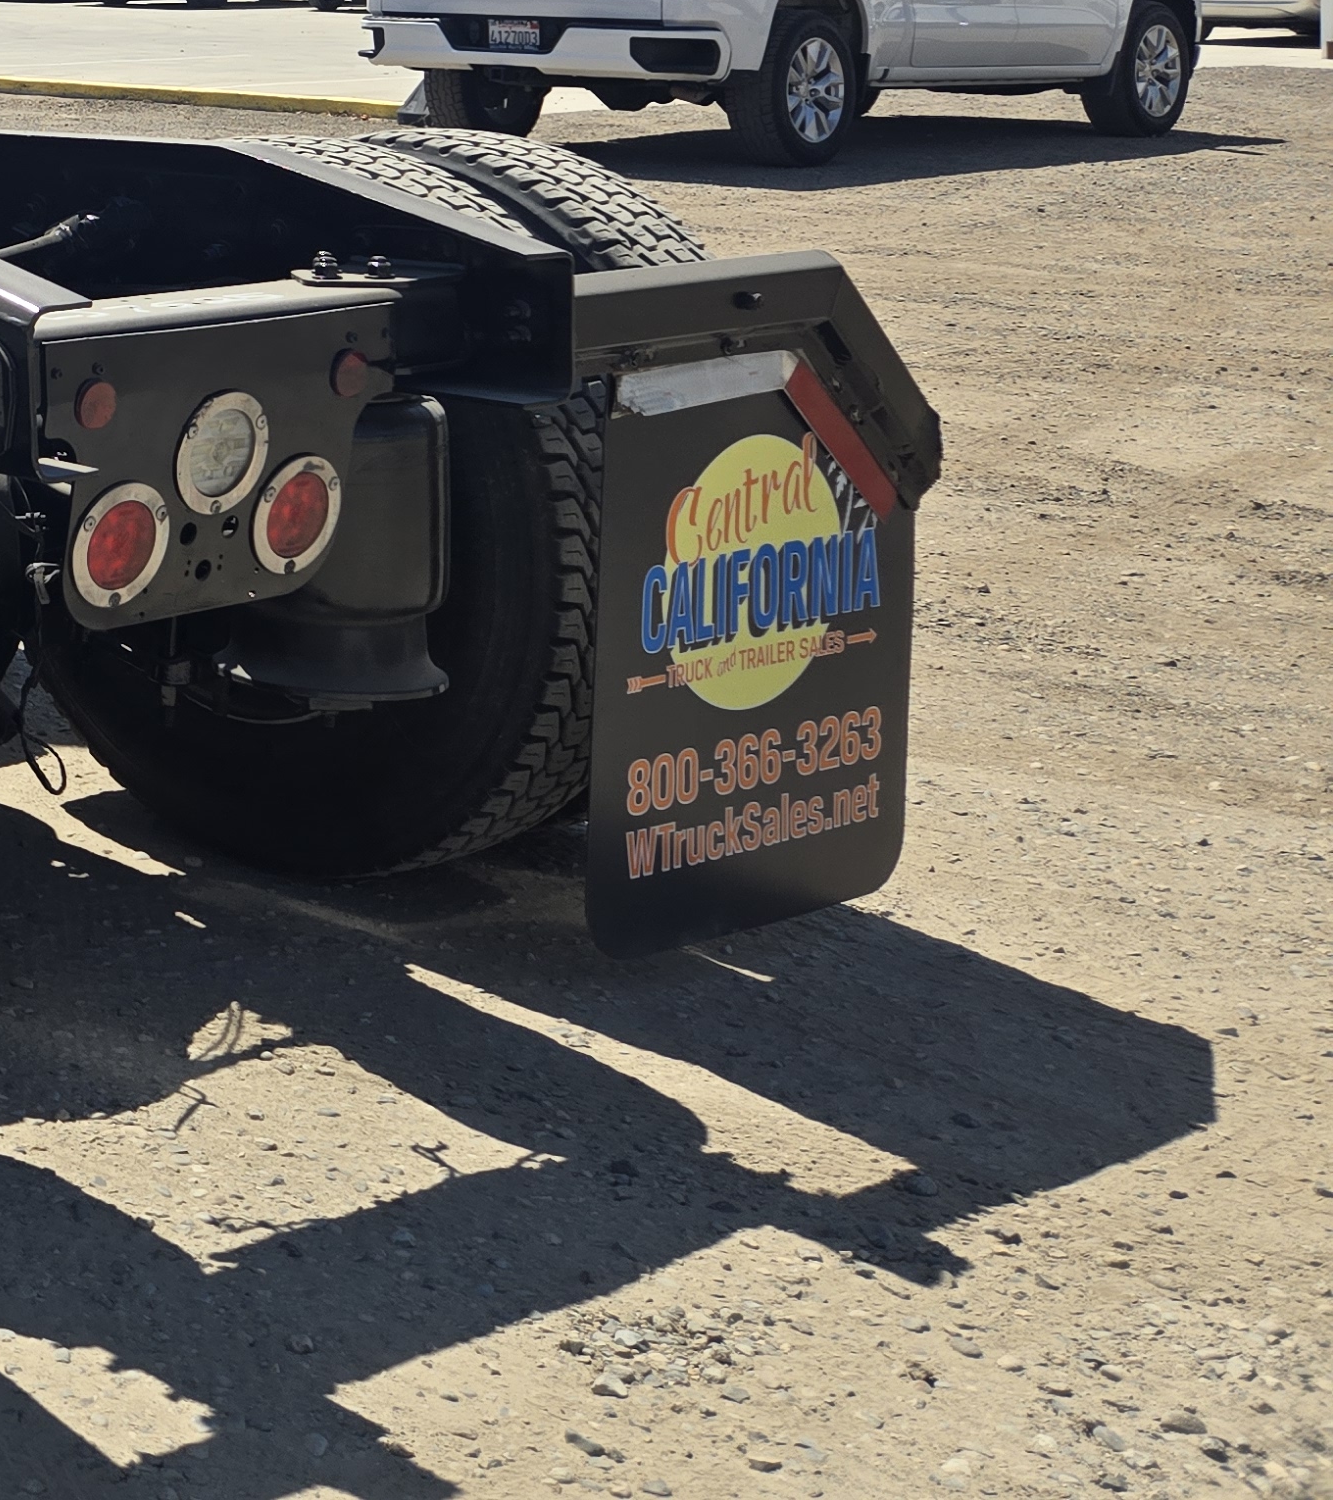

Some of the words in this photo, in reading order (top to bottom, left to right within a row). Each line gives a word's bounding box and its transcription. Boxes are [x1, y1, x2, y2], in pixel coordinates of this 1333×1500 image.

[666, 431, 818, 567] Central
[641, 527, 881, 654] CALIFORNIA
[666, 657, 714, 688] TRUCK
[717, 645, 737, 677] and
[738, 641, 795, 671] TRAILER
[799, 630, 845, 659] SALES
[626, 705, 882, 816] 800-366-3263
[625, 772, 880, 879] WTruckSales.net
